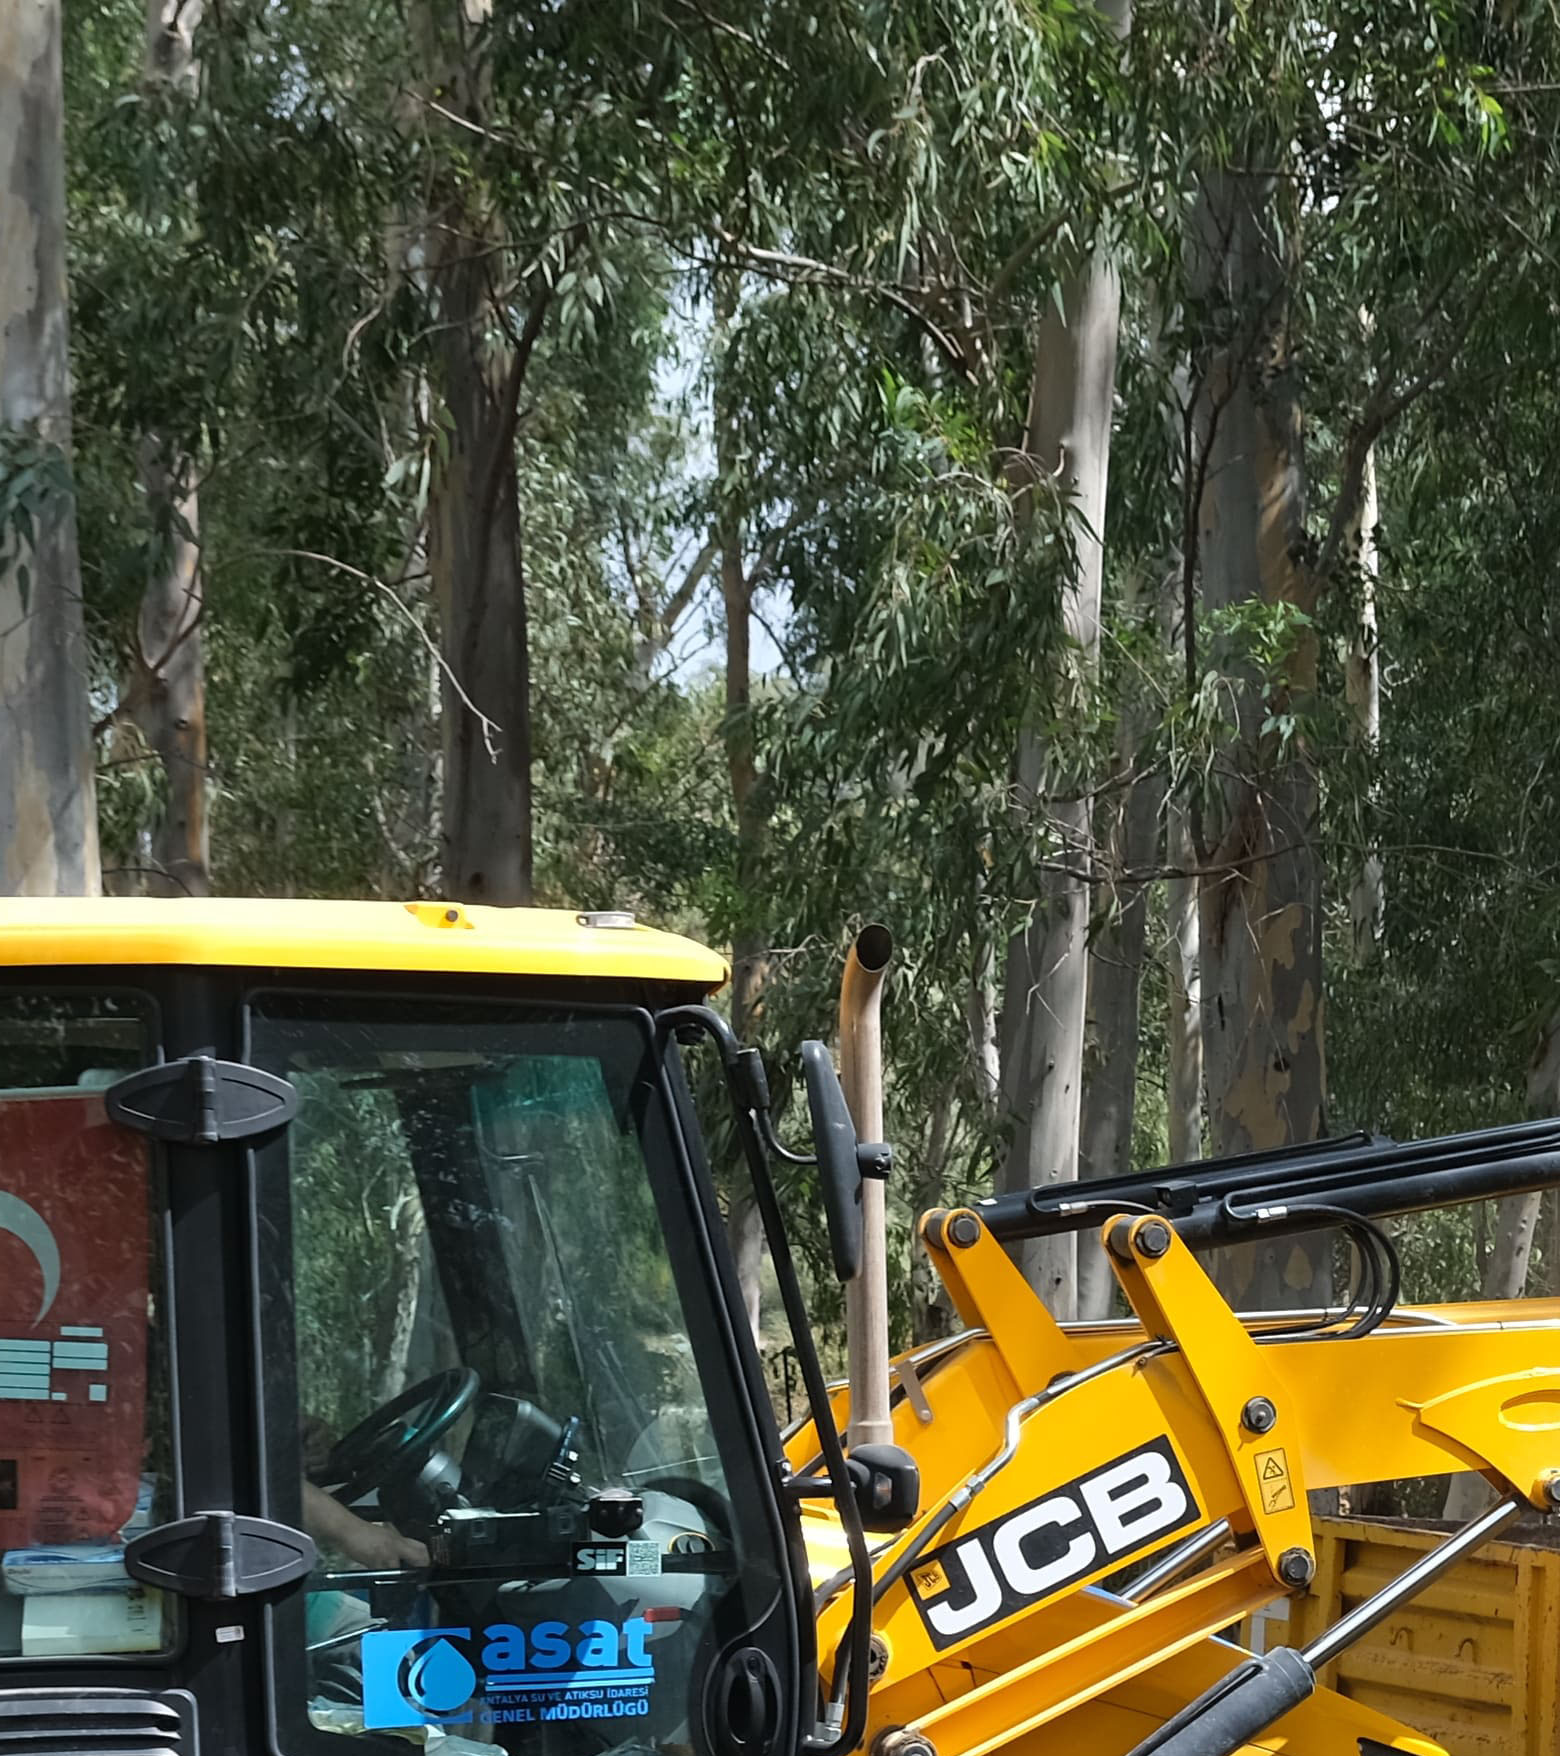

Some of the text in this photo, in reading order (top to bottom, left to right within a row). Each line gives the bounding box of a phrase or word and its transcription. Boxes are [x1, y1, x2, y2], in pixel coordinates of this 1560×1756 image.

[926, 1451, 1187, 1635] JCB
[481, 1616, 654, 1671] asat
[564, 1688, 604, 1701] ATIKSU
[480, 1708, 536, 1724] GENEL
